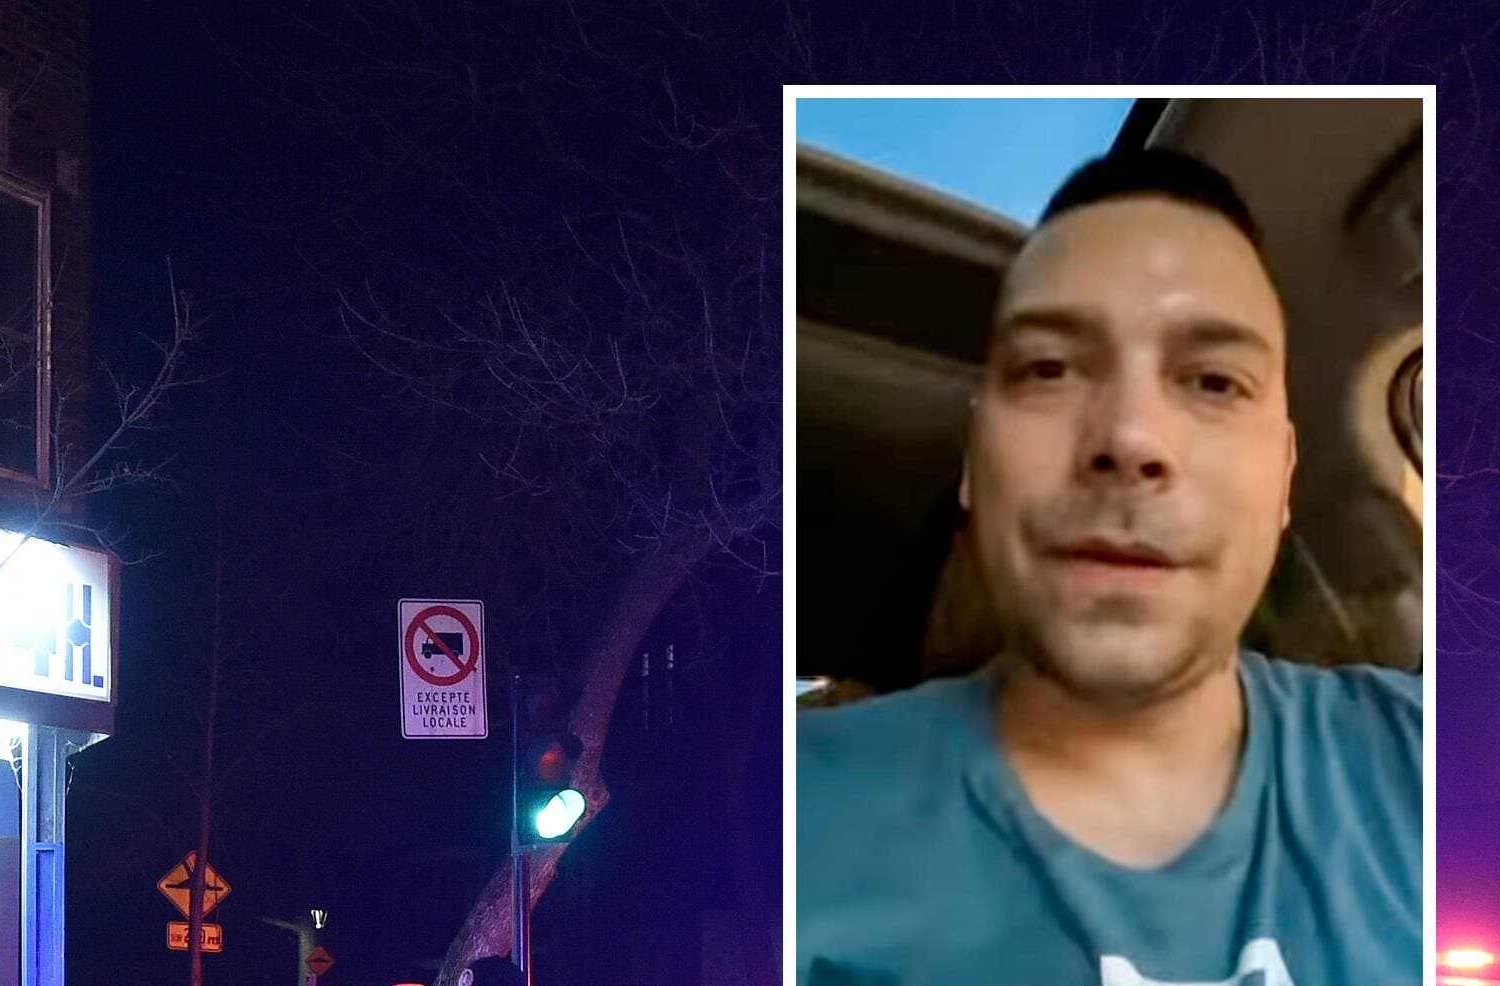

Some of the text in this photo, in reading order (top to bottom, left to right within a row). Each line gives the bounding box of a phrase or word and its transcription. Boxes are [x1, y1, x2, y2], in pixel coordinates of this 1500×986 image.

[417, 691, 470, 703] EXCEPTE
[412, 704, 476, 716] LIVRAISON
[423, 717, 467, 728] LOCALE
